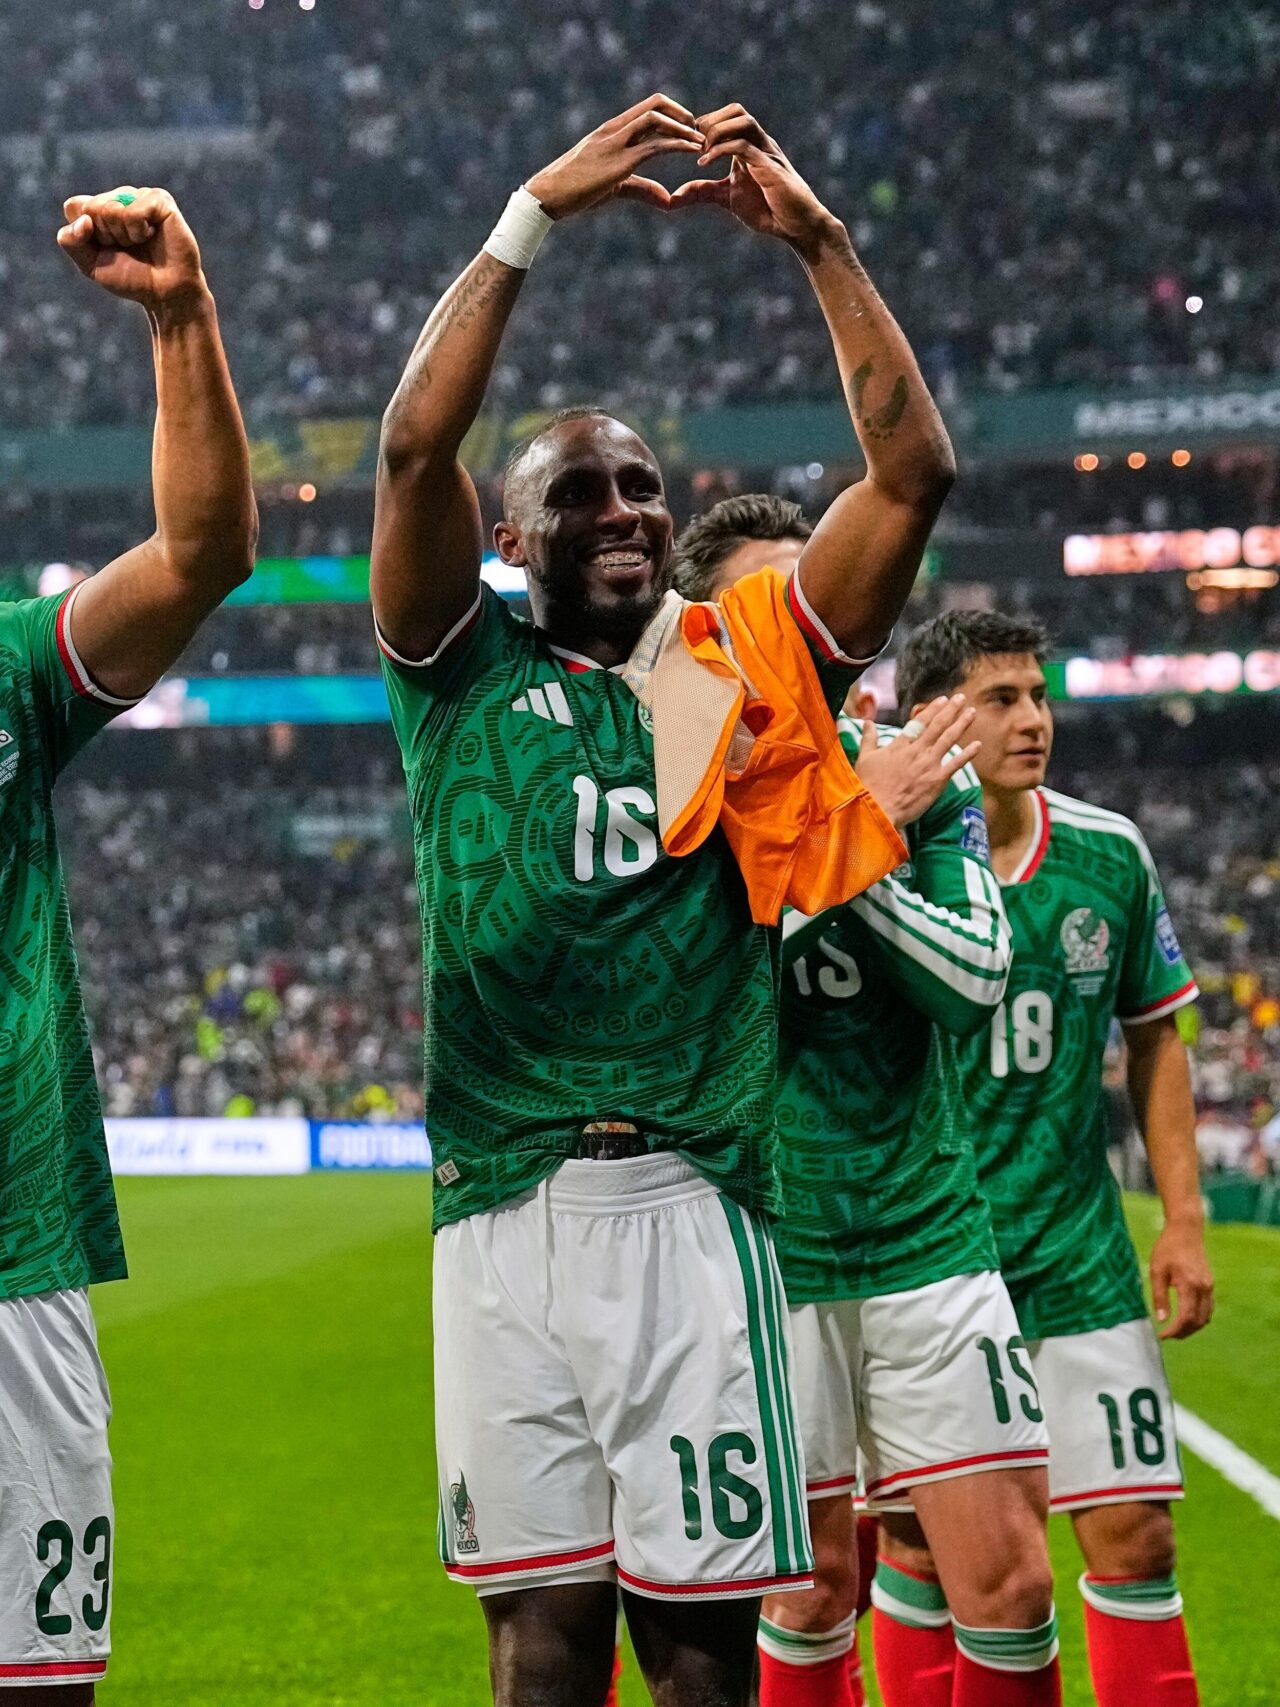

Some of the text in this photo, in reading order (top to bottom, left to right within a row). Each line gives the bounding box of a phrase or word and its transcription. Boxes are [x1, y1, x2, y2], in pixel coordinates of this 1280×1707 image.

[573, 775, 657, 881] 16
[991, 990, 1053, 1078] 18
[976, 1336, 1043, 1423] 15
[1098, 1388, 1165, 1468] 18
[670, 1432, 762, 1540] 16
[36, 1516, 110, 1635] 23
